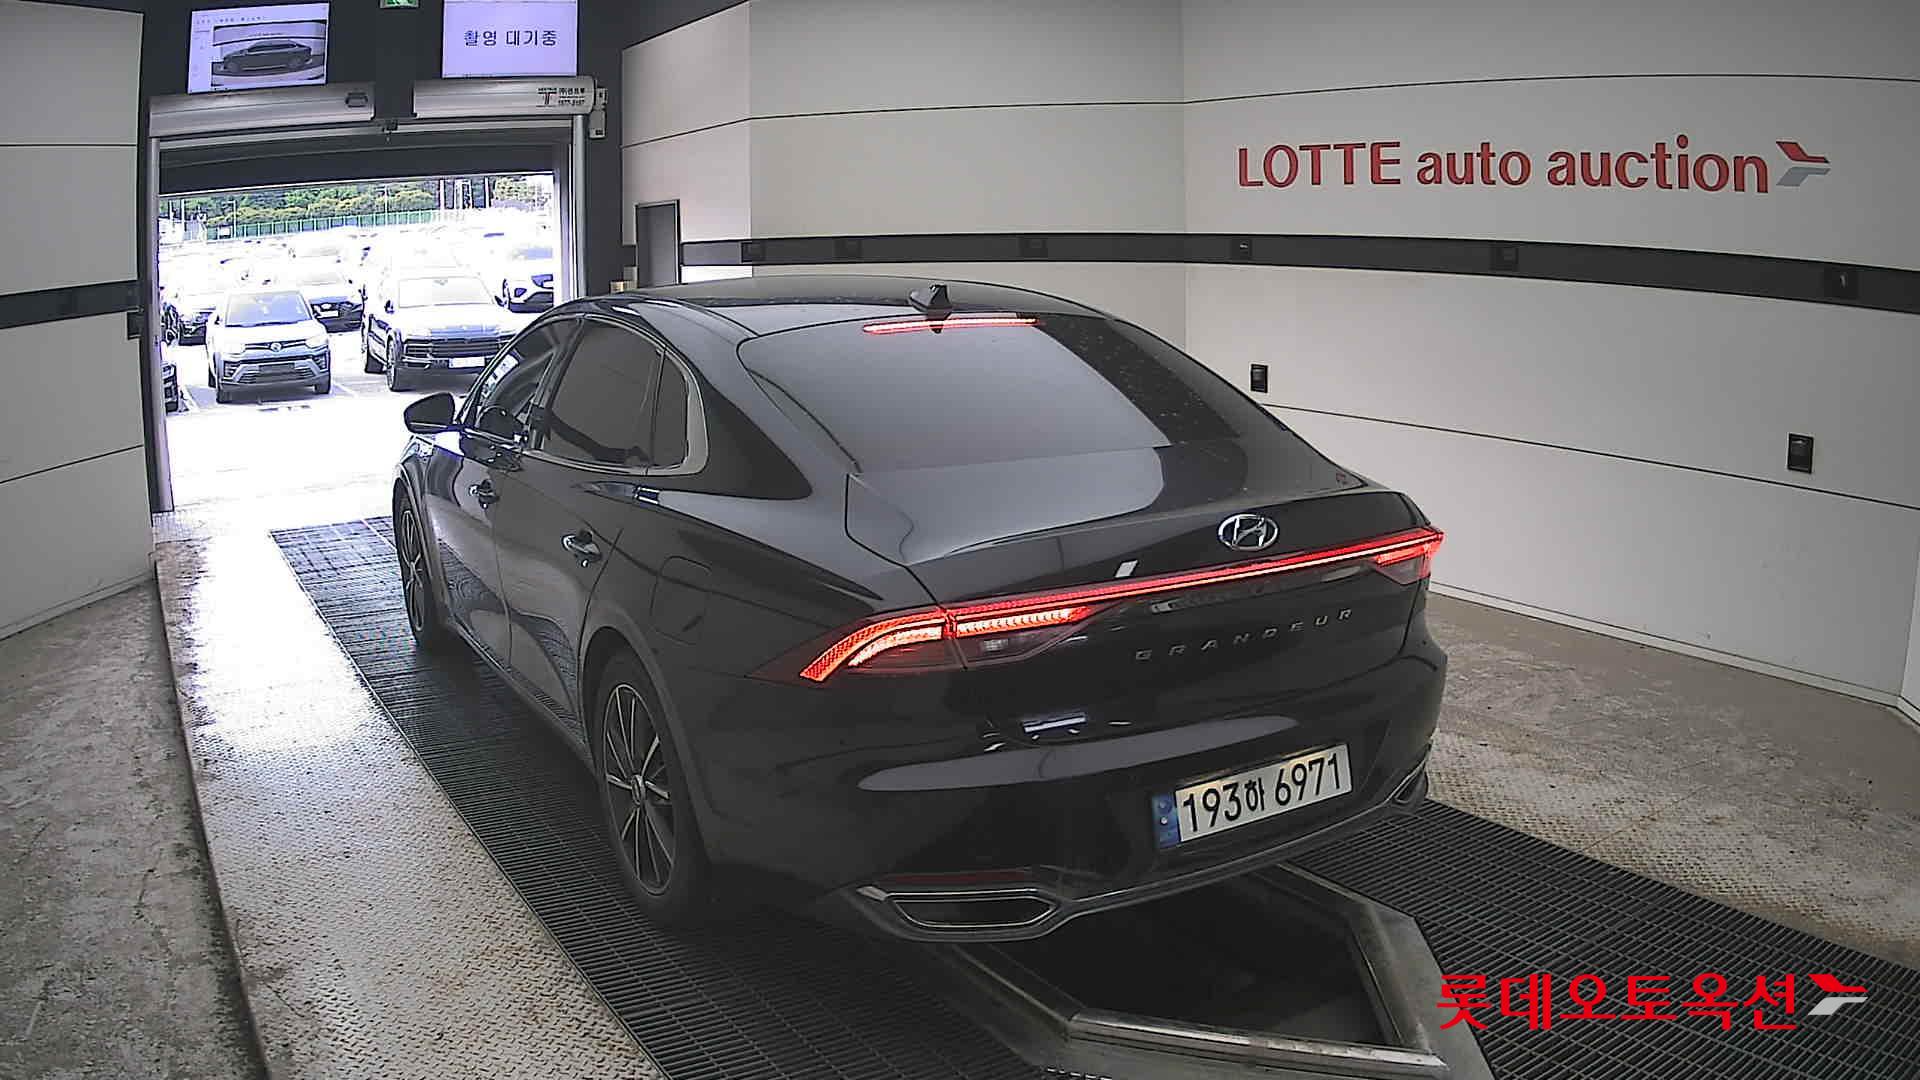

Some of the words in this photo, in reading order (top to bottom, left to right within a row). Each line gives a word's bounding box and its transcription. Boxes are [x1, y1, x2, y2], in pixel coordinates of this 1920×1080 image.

[464, 30, 497, 46] 촬영
[506, 30, 557, 46] 대기중
[1238, 142, 1401, 188] LOTTE
[1416, 142, 1532, 186] auto
[1547, 134, 1769, 193] auction
[1136, 608, 1352, 660] GRANDEUR
[1182, 777, 1265, 833] 193하
[1274, 753, 1341, 806] 6971
